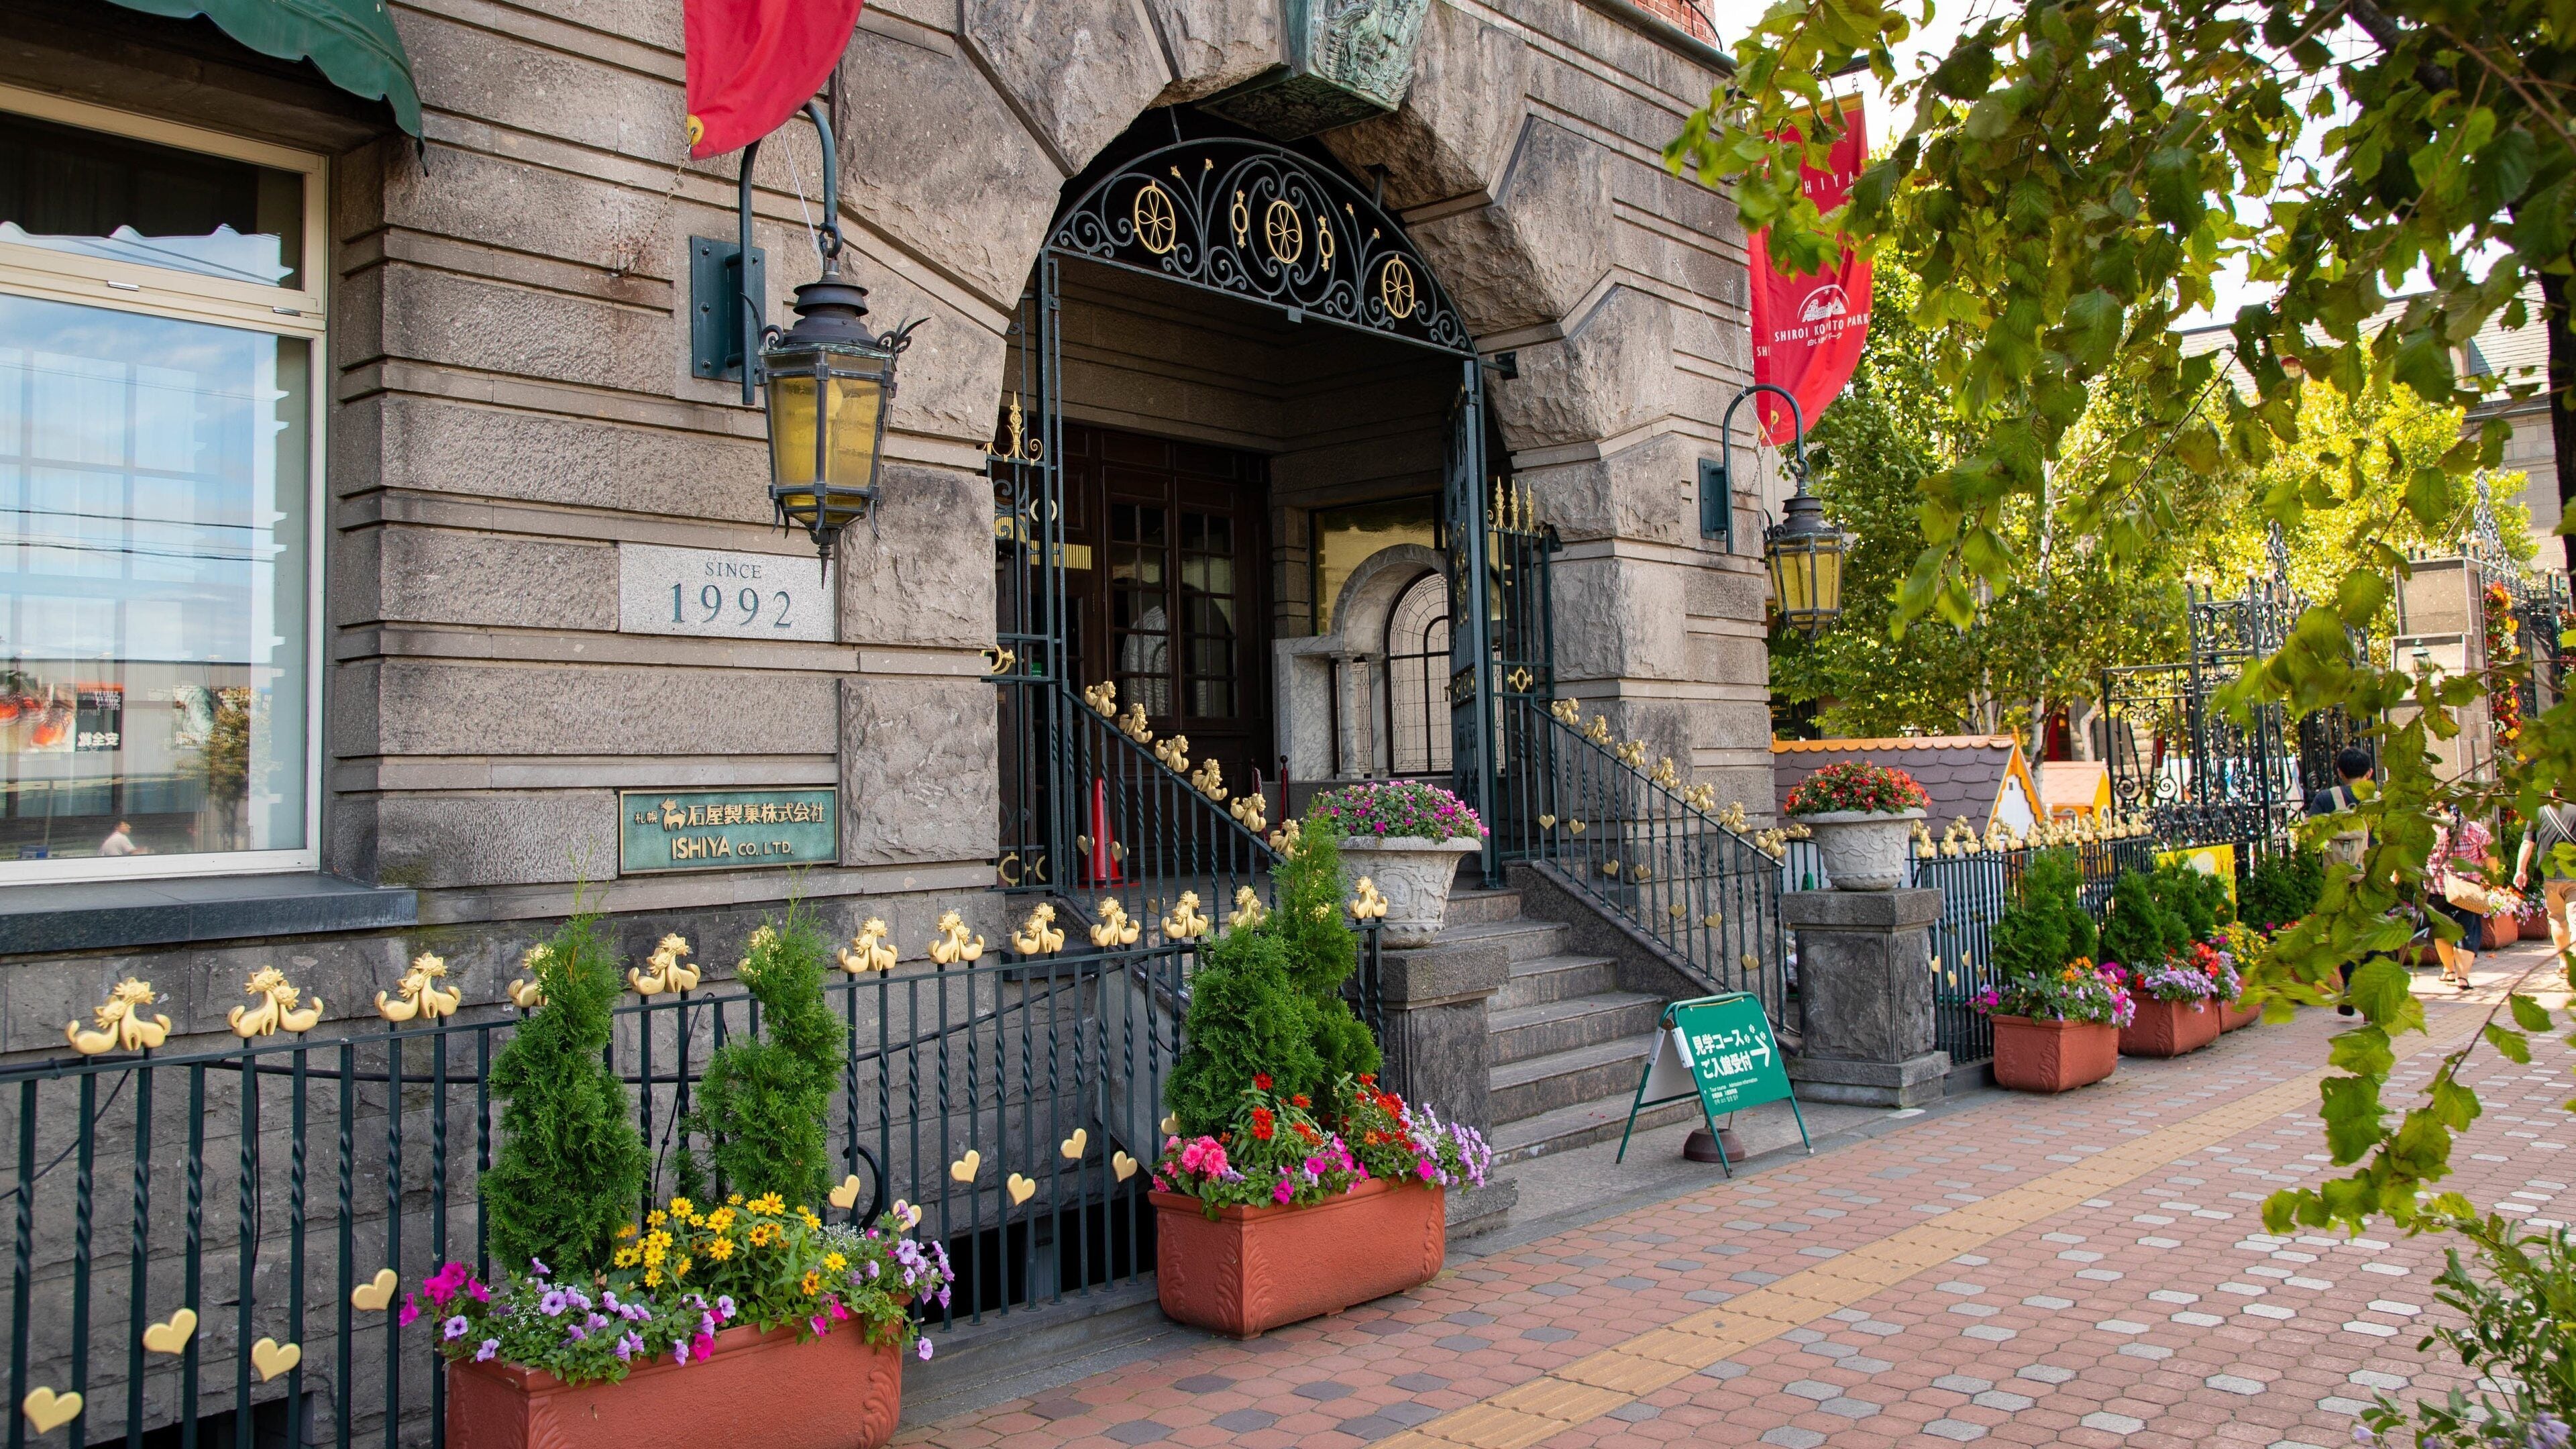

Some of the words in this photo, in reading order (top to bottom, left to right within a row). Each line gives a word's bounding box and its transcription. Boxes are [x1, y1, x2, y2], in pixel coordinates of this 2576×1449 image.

[1805, 171, 1854, 194] HIYA
[1774, 327, 1809, 342] SHIROI
[1847, 313, 1869, 327] PARK
[705, 562, 762, 579] SINCE
[672, 583, 793, 629] 1992
[635, 810, 658, 824] 札幌
[686, 802, 826, 826] 石屋製菓株式会社
[672, 836, 732, 860] ISHIYA
[763, 841, 794, 855] LTD.
[1692, 1029, 1745, 1056] 見学コース
[1701, 1051, 1753, 1079] ご入館受付
